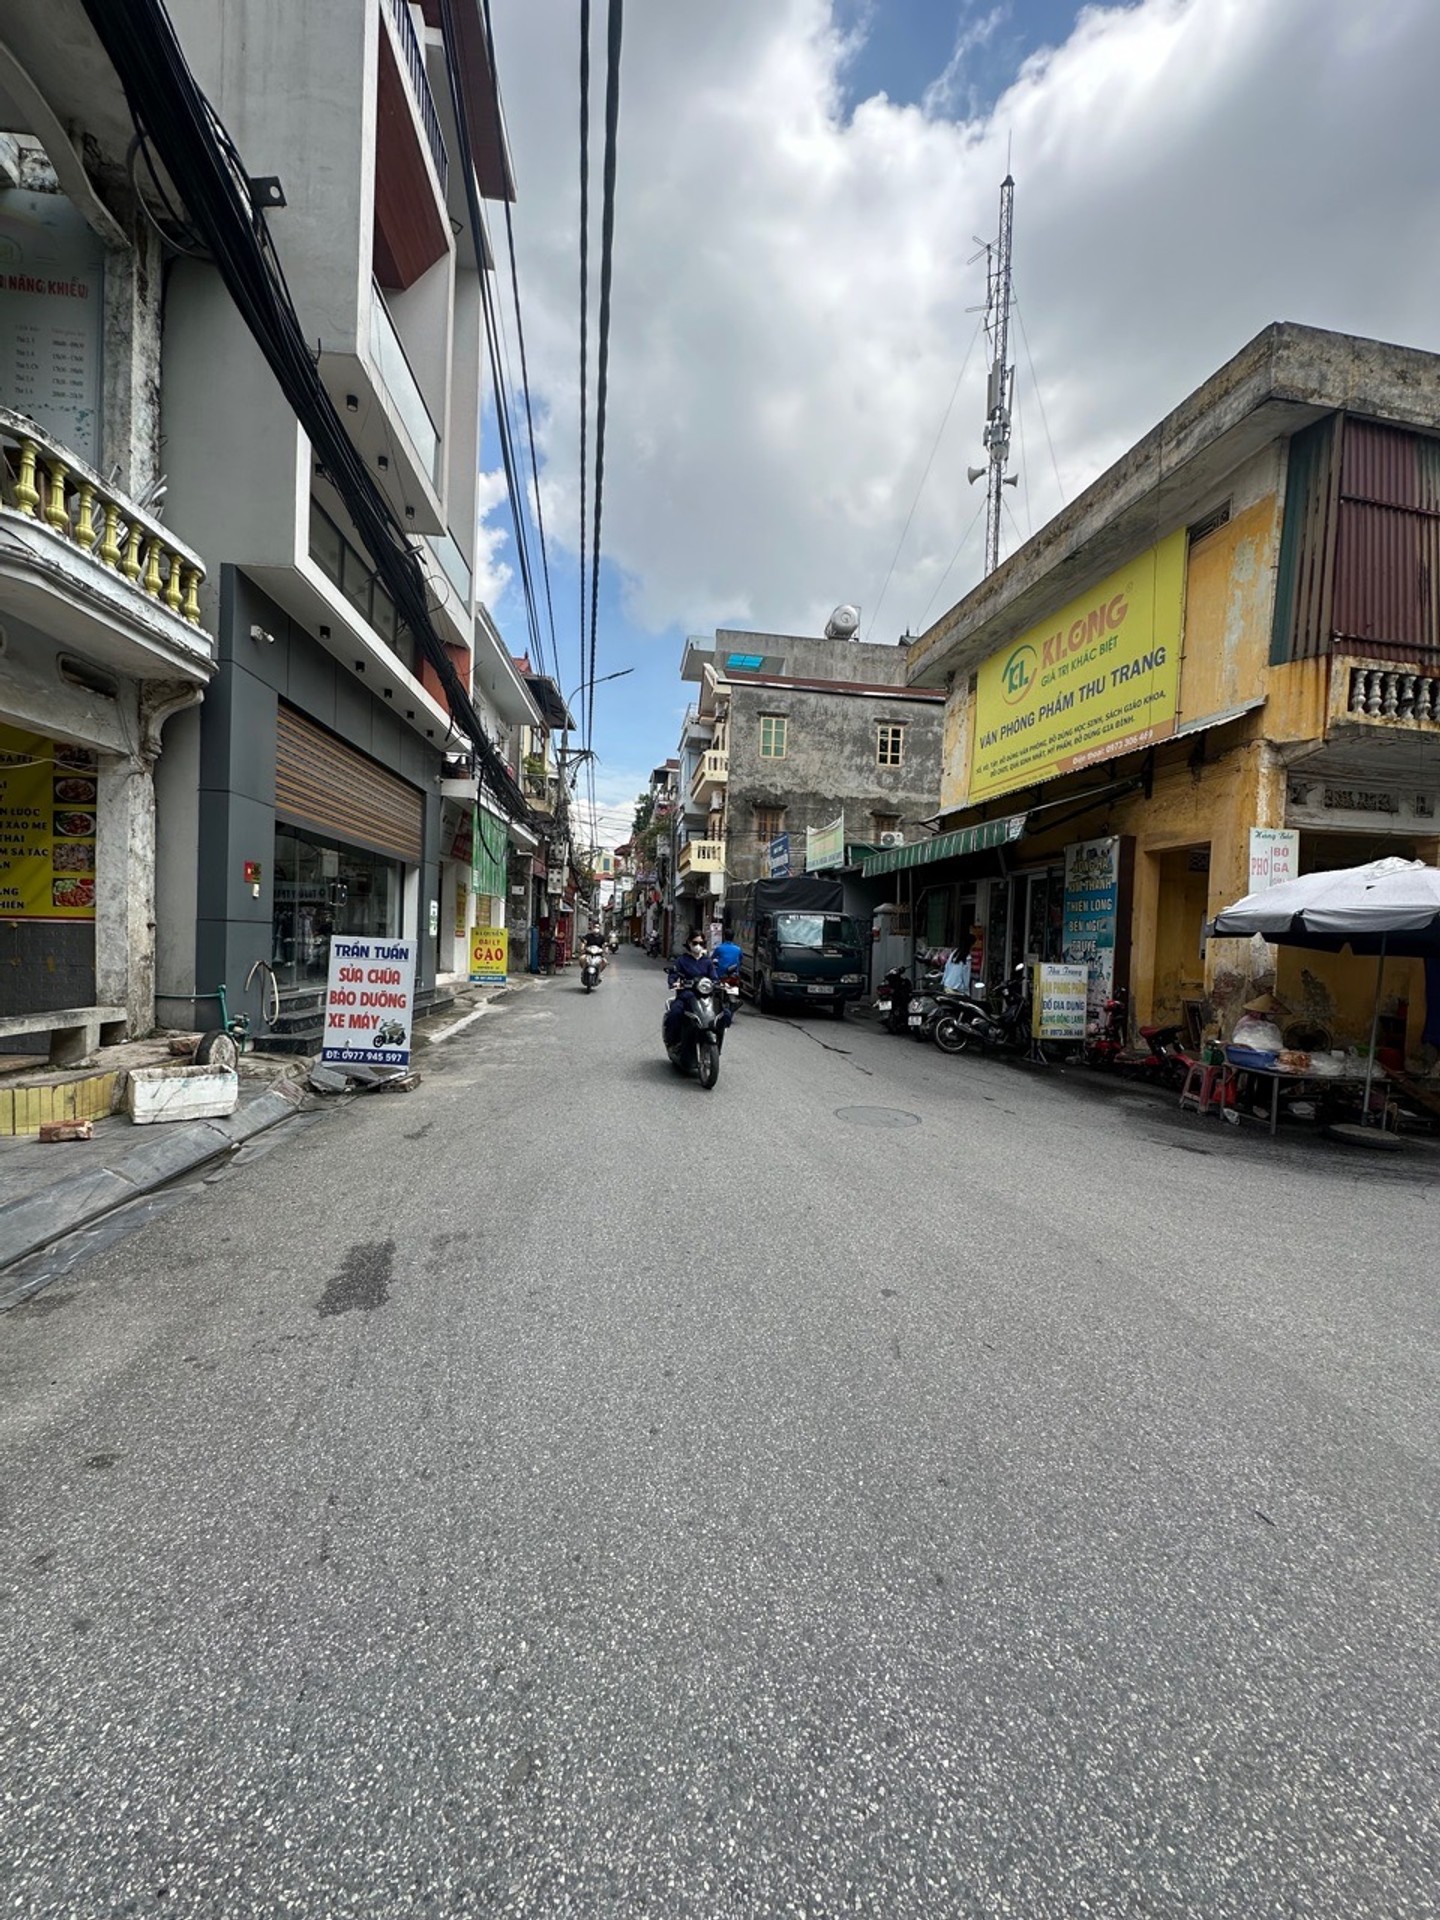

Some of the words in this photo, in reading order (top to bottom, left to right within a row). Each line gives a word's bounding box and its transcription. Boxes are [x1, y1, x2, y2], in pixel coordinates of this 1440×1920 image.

[1041, 593, 1129, 670] KLONG
[1099, 636, 1119, 657] BIỆT
[979, 729, 998, 750] VĂN
[1000, 711, 1035, 740] PHÒNG
[1038, 691, 1075, 722] PHẨM
[1078, 676, 1106, 703] THU
[1110, 646, 1166, 687] TRANG
[1105, 706, 1123, 721] SÁCH
[1123, 698, 1143, 713] GIÁO
[1143, 690, 1166, 705] KHOA,
[1101, 723, 1114, 734] GIA
[1090, 898, 1112, 911] LONG
[374, 942, 409, 960] TUẤN
[474, 947, 504, 964] GẠO
[339, 963, 364, 983] SỬA
[367, 967, 401, 985] CHỮA
[329, 986, 356, 1006] BẢO
[360, 990, 407, 1009] DƯỠNG
[1053, 1000, 1065, 1010] GIA
[328, 1013, 345, 1028] XE
[348, 1011, 381, 1030] MÁY
[326, 1050, 340, 1059] ĐT:
[342, 1050, 364, 1060] 0977
[366, 1051, 384, 1061] 945
[386, 1052, 402, 1062] 597
